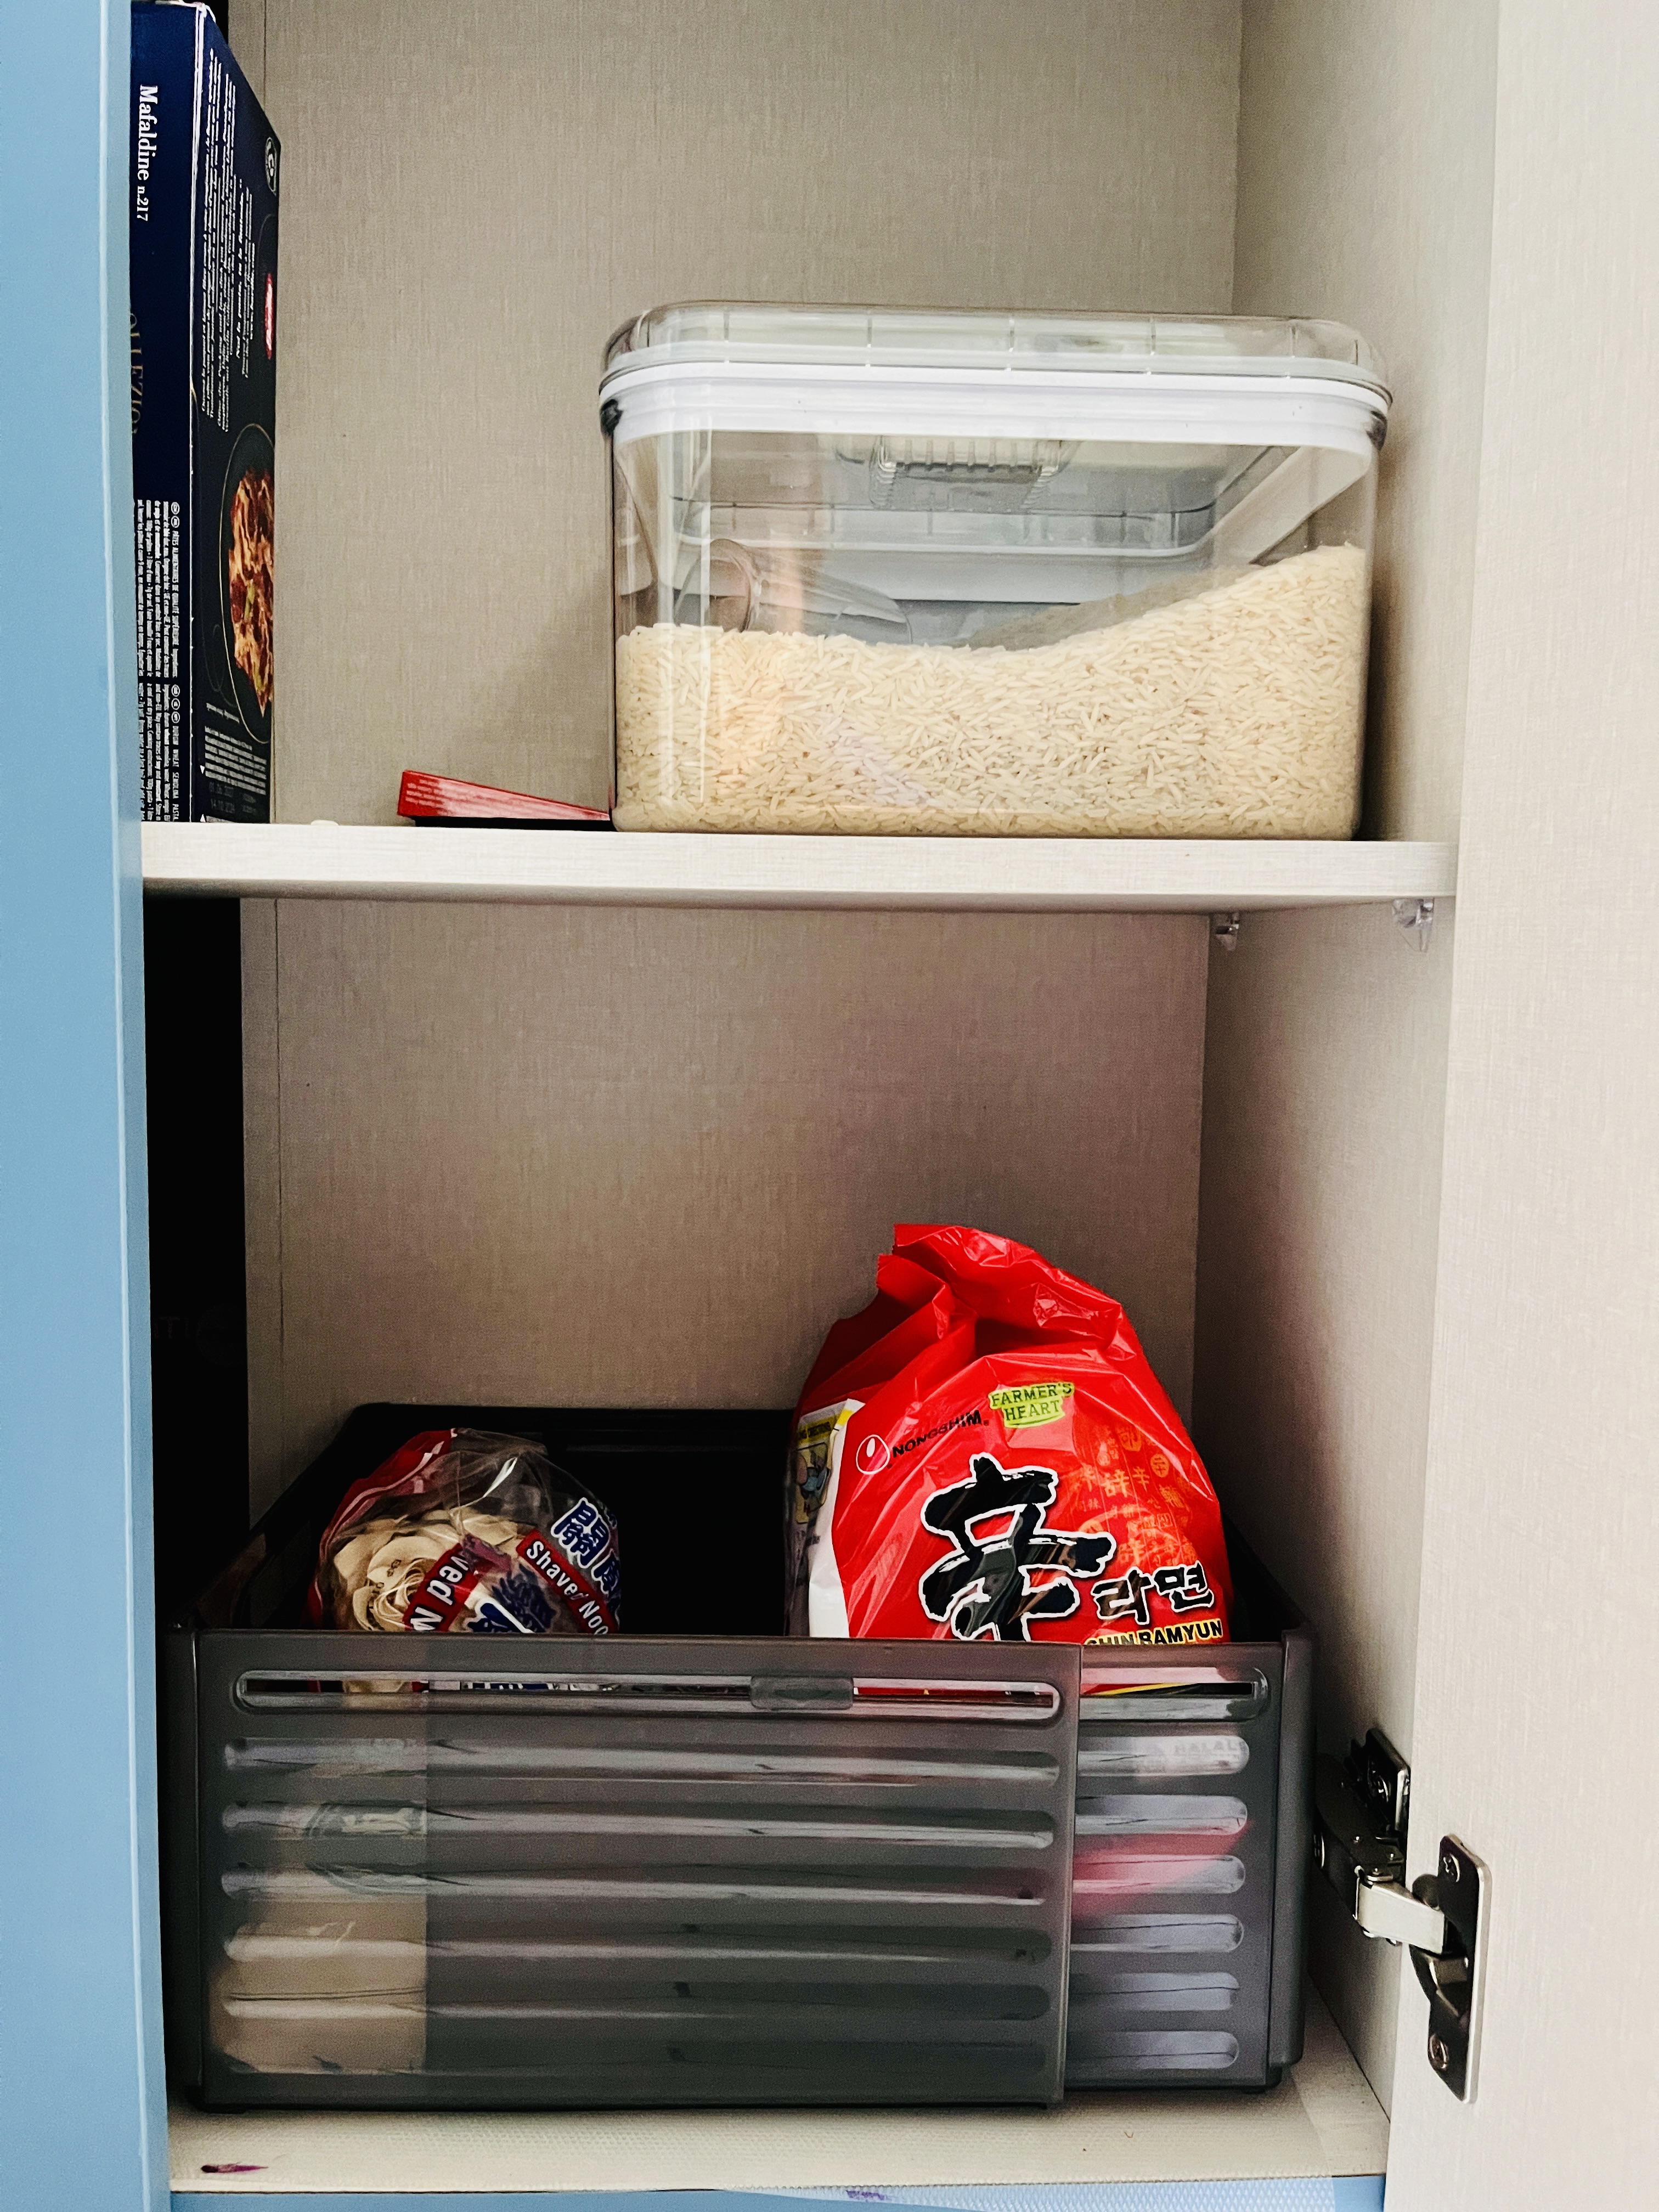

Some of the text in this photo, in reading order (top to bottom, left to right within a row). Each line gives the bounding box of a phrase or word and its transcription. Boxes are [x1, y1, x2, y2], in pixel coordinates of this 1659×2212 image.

[137, 85, 158, 221] Mafaldine n.217
[991, 1382, 1073, 1407] FARMER'S
[1004, 1400, 1060, 1421] HEART
[892, 1409, 982, 1458] NONGSHIM
[1090, 1561, 1216, 1626] 라면
[578, 1600, 610, 1634] Noo
[1138, 1619, 1223, 1645] RAMYUN
